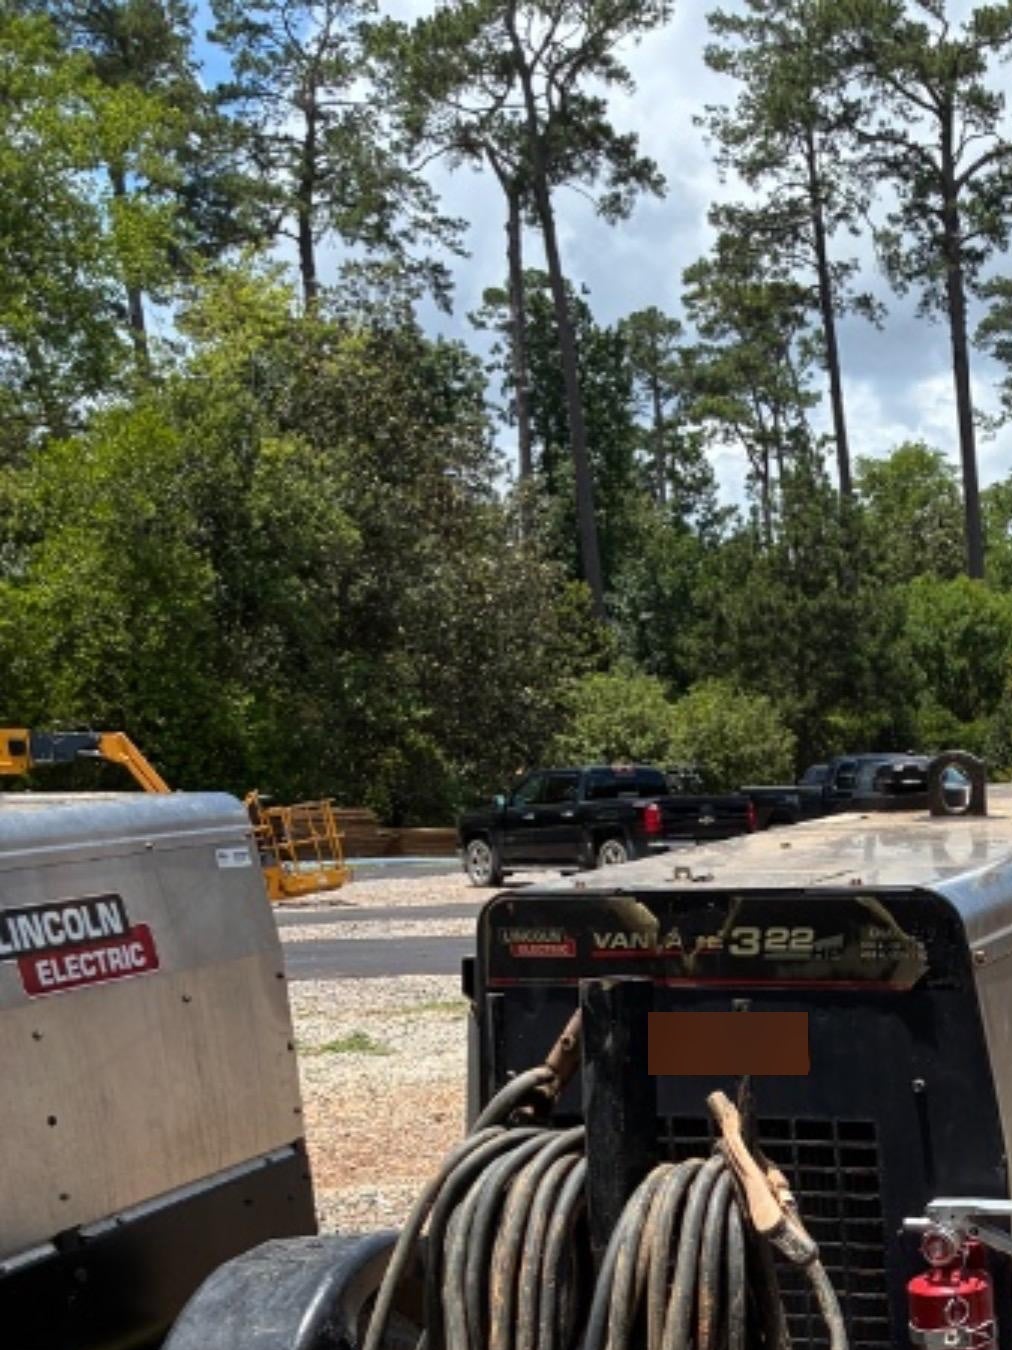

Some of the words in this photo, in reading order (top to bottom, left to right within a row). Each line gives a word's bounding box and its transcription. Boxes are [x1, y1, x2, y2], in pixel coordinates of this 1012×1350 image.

[593, 927, 723, 949] VANAE
[729, 926, 814, 956] 322
[35, 944, 146, 986] ELECTRIC
